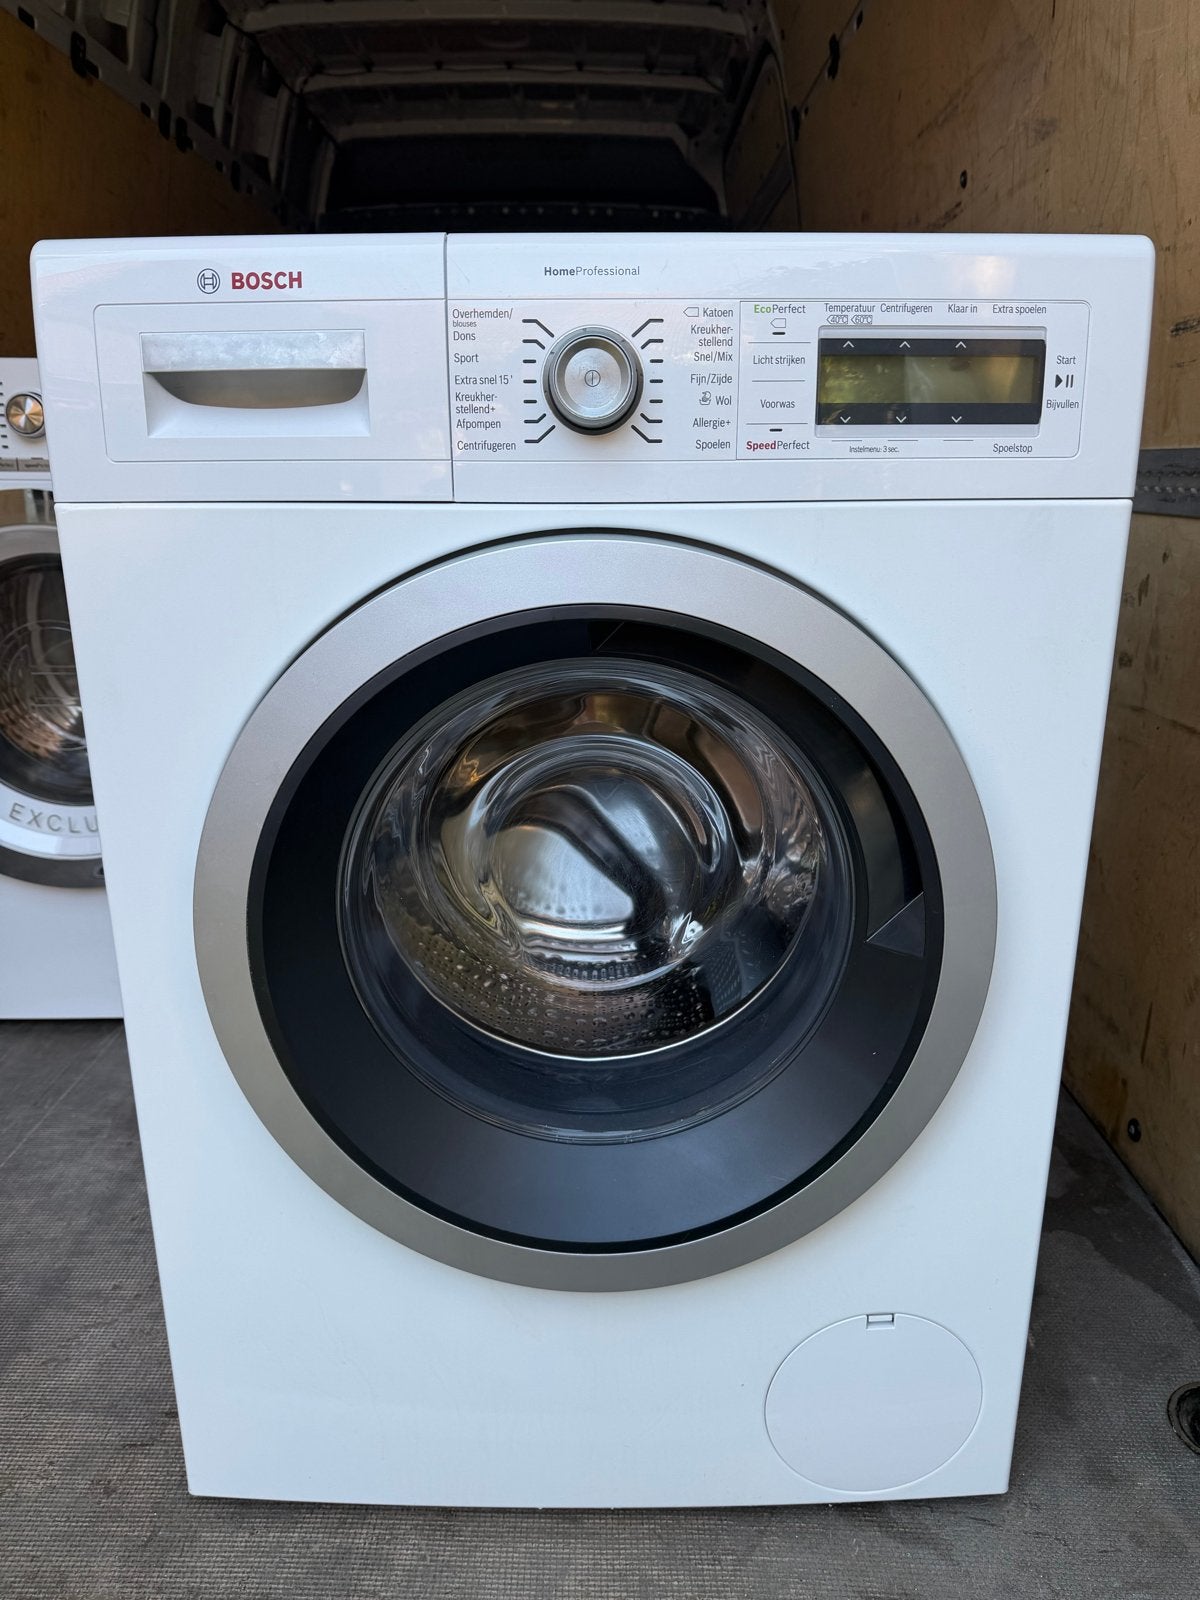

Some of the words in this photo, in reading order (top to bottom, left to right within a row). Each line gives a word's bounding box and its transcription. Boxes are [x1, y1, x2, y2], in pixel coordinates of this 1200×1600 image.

[544, 266, 640, 276] HomeProfessional
[231, 271, 303, 290] BOSCH
[452, 308, 514, 320] Overhemden/
[703, 307, 734, 317] Katoen
[754, 304, 806, 314] EcoPerfect
[824, 303, 875, 314] Temperatuur
[880, 303, 933, 314] Centrifugeren
[948, 304, 969, 313] Klaar
[970, 304, 978, 313] in
[992, 304, 1014, 313] Extra
[1015, 304, 1047, 315] spoelen
[452, 320, 477, 328] blouses
[690, 324, 734, 335] Kreukher-
[453, 331, 476, 341] Dons
[698, 337, 733, 347] stellend
[454, 353, 479, 364] Sport
[693, 351, 733, 363] Snel/Mix
[753, 355, 774, 365] Licht
[775, 355, 806, 367] strijken
[1056, 355, 1076, 365] Start
[454, 375, 478, 385] Extra
[479, 375, 498, 385] snel
[690, 373, 733, 386] Fijn/Zijde
[455, 392, 498, 402] Kreukher-
[715, 395, 732, 405] Wol
[455, 404, 496, 414] stellend+
[760, 399, 796, 409] Voorwas
[1046, 399, 1080, 410] Bijvullen
[456, 419, 501, 431] Afpompen
[692, 417, 731, 429] Allergie+
[457, 441, 516, 452] Centrifugeren
[695, 439, 731, 451] Spoelen
[746, 440, 810, 451] SpeedPerfect
[992, 443, 1033, 454] Spoelstop
[9, 802, 99, 834] EXCLU
